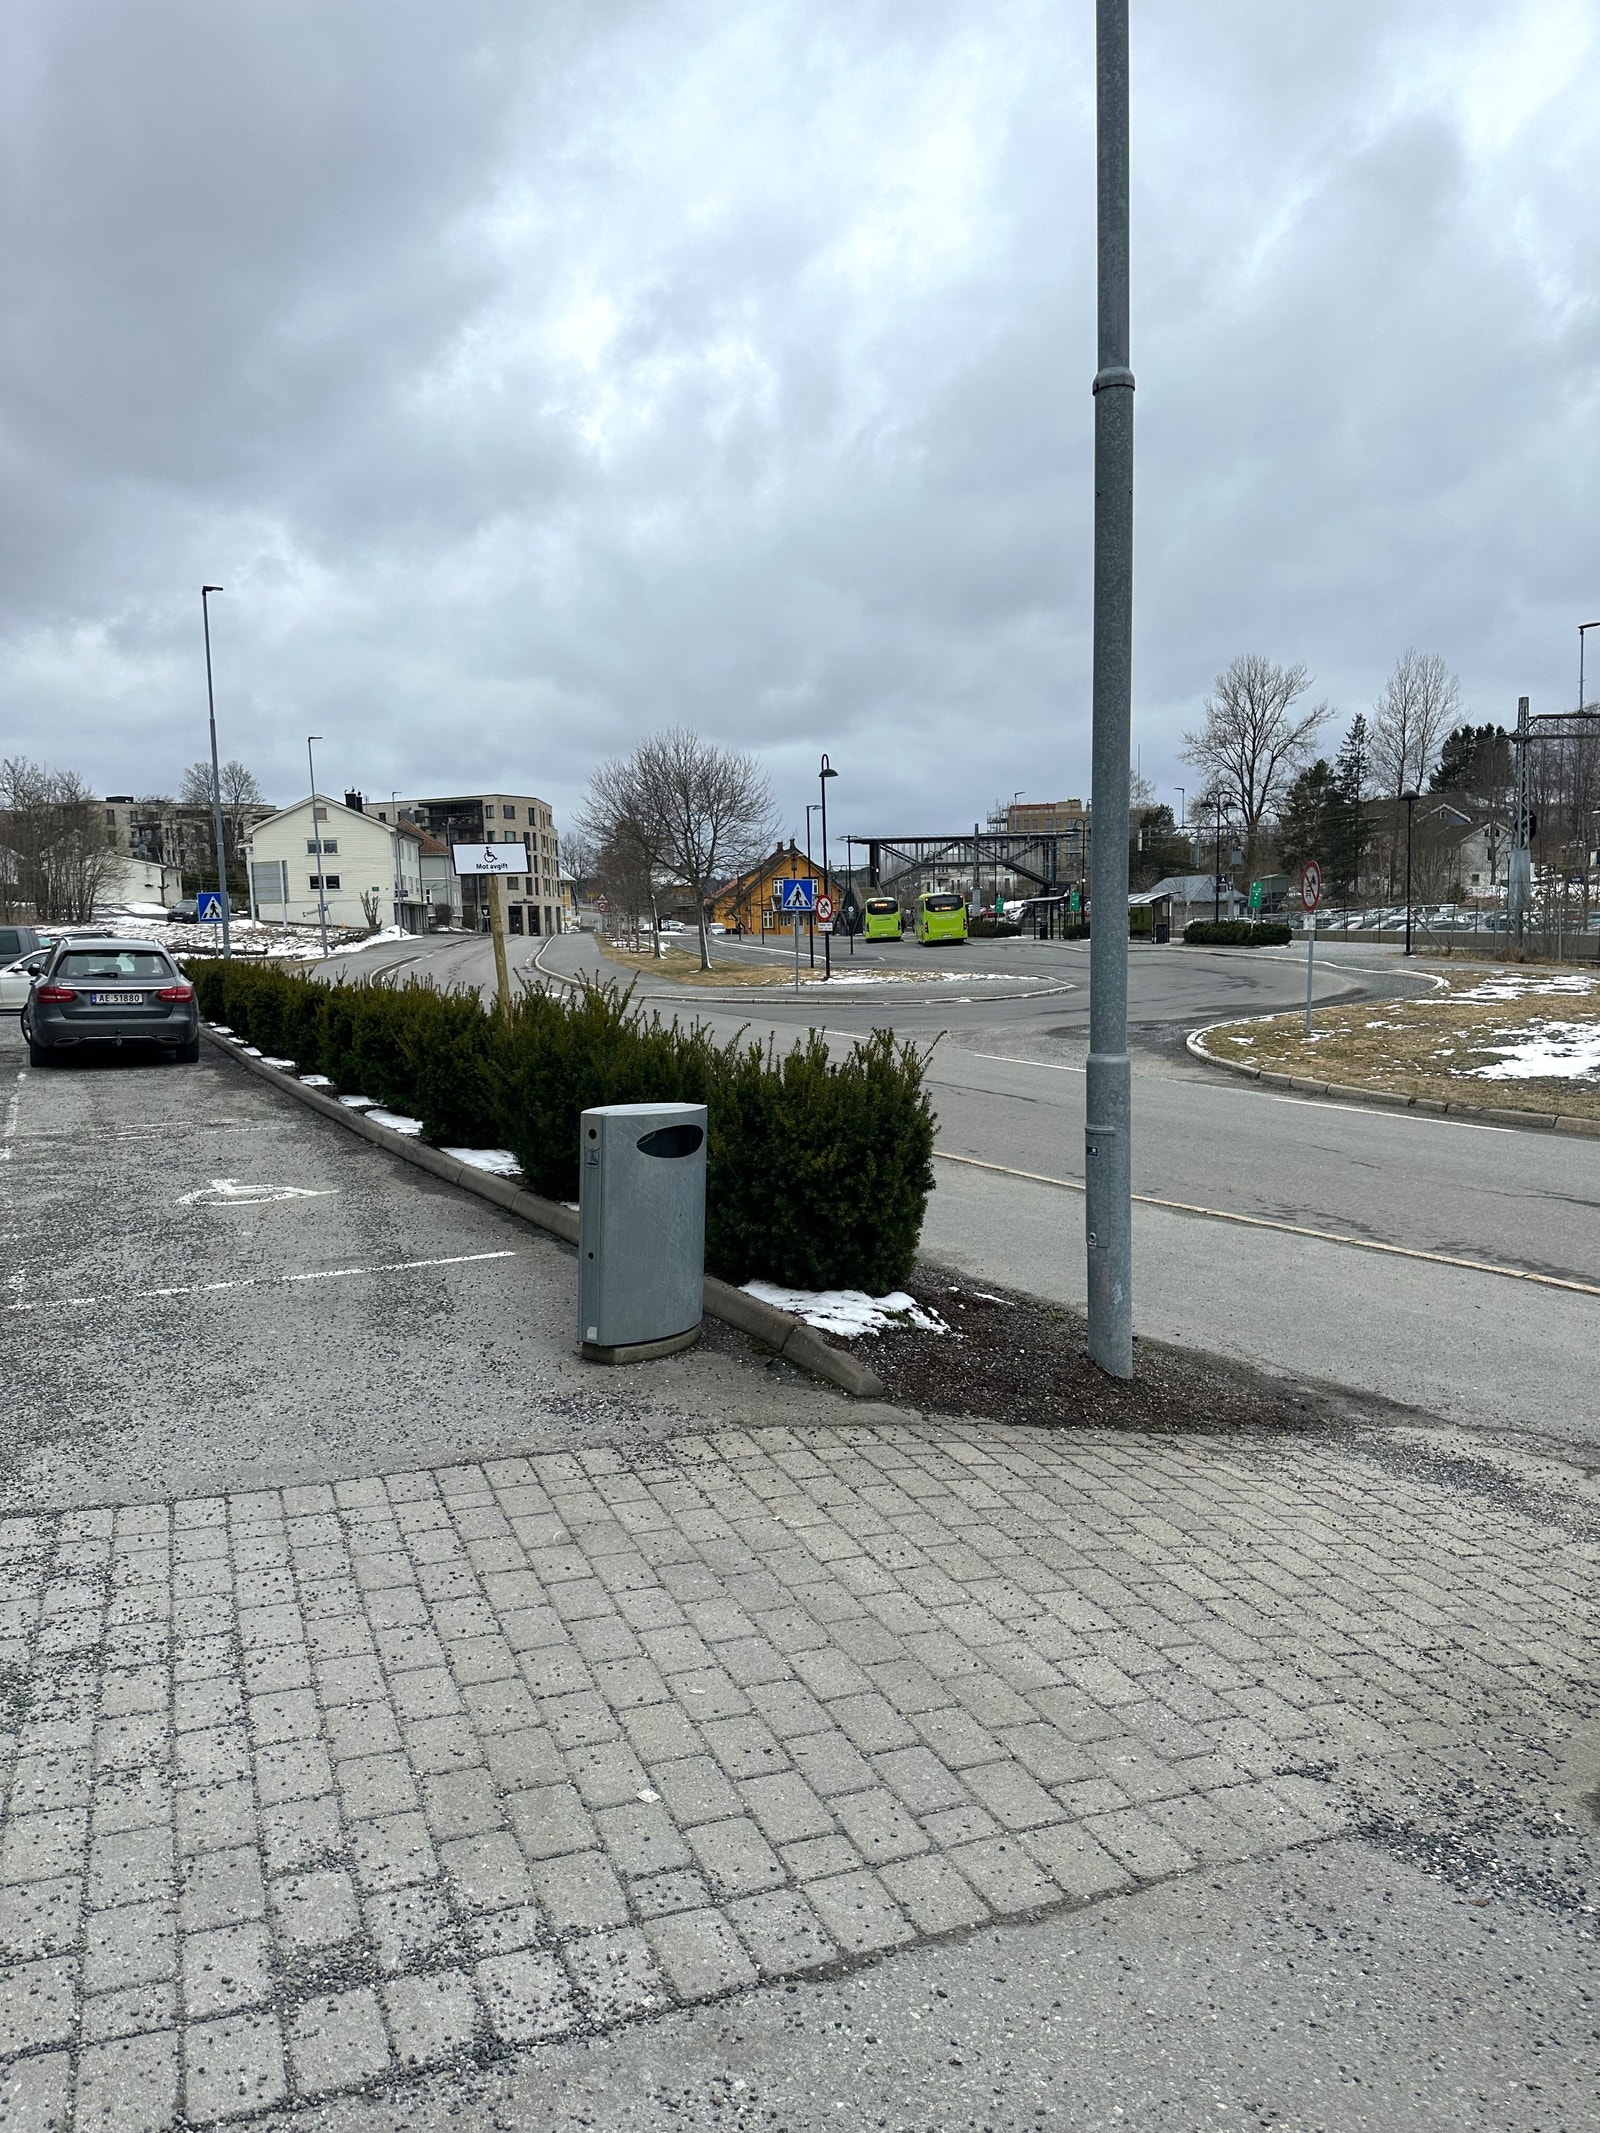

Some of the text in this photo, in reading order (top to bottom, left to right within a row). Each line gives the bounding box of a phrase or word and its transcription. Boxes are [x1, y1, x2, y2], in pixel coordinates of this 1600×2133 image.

[490, 863, 508, 871] avgift
[99, 994, 139, 1002] AE 51880
